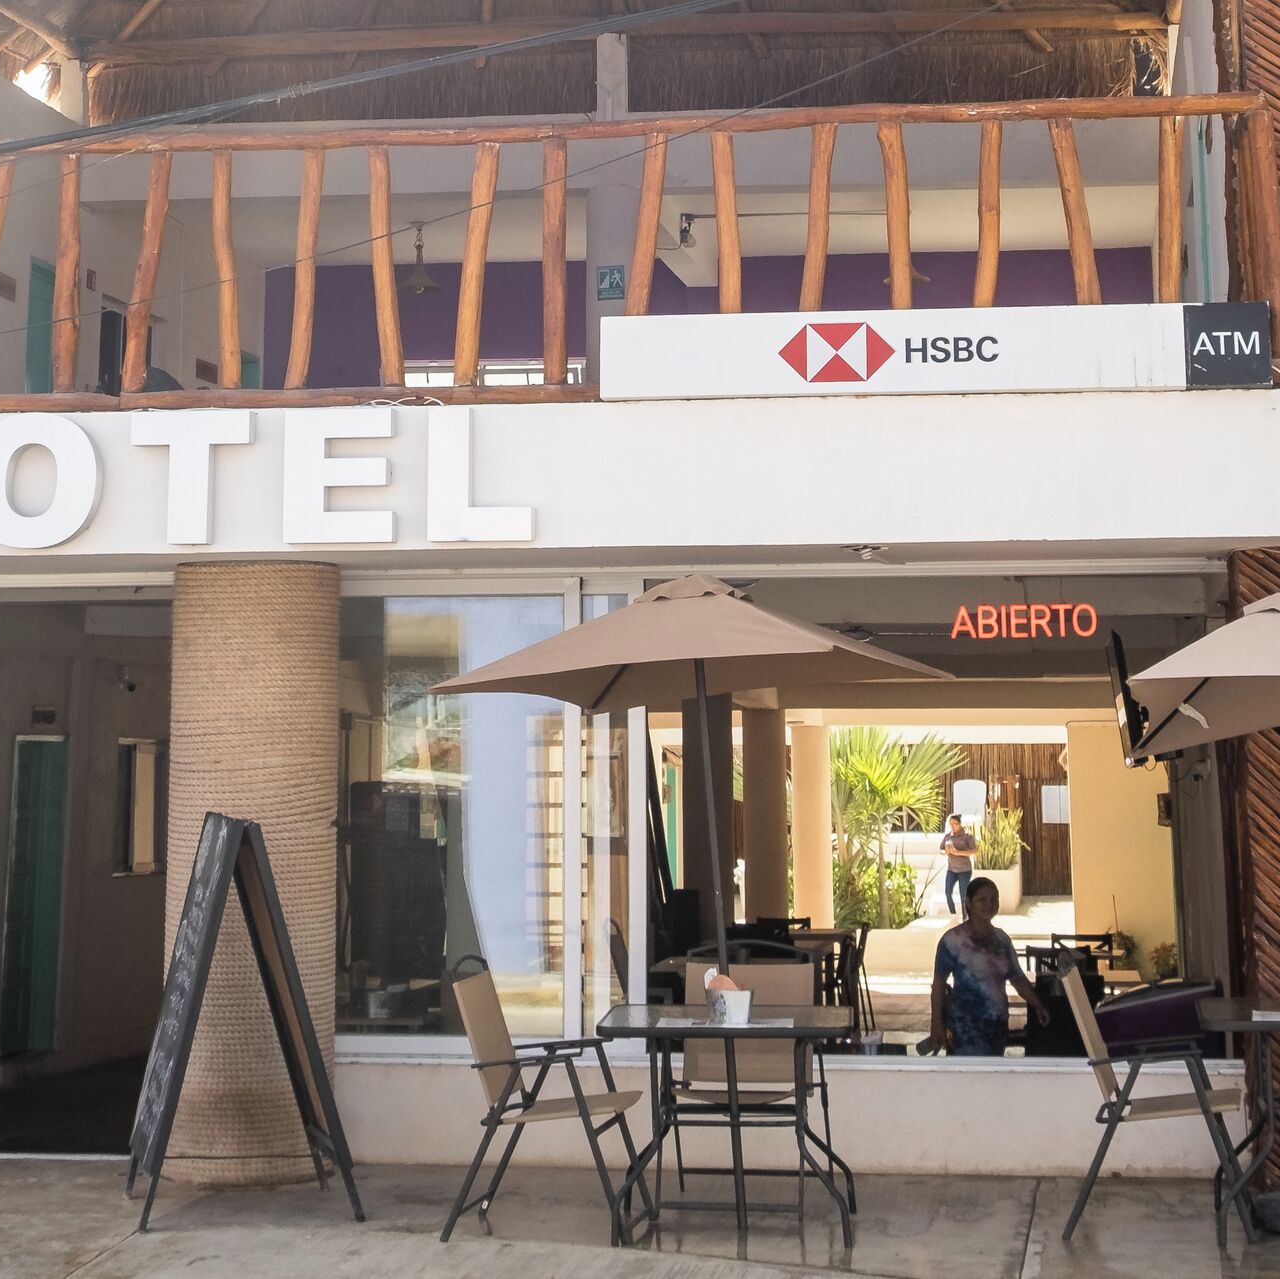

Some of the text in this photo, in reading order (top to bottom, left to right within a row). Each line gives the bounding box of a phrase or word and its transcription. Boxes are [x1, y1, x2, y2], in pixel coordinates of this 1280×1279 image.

[904, 336, 999, 363] HSBC
[1193, 331, 1261, 357] ATM
[950, 603, 1098, 639] ABIERTO
